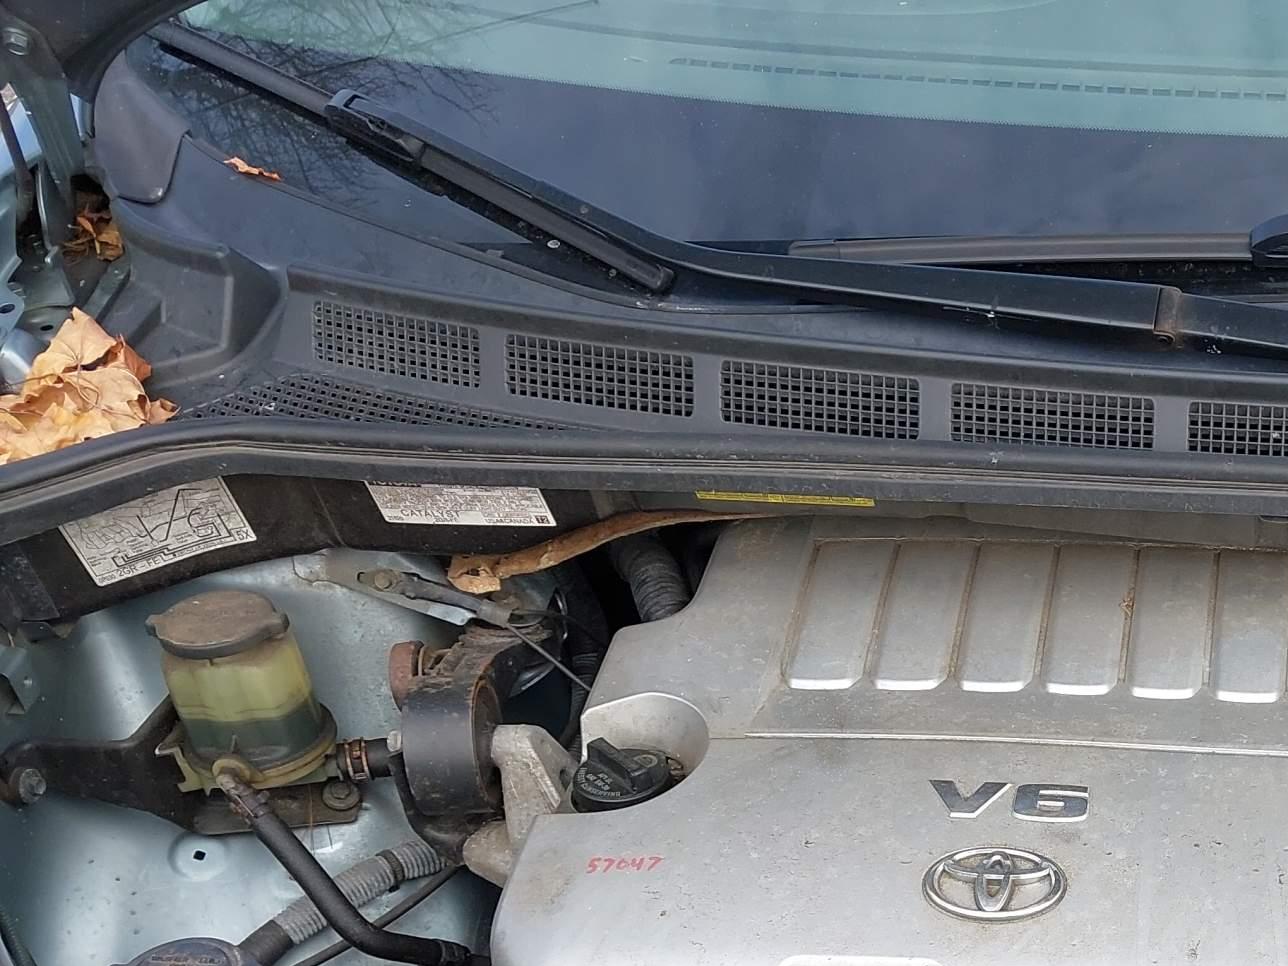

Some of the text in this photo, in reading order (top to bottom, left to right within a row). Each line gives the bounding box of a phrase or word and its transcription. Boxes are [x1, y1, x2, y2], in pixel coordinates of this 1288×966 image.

[400, 509, 460, 518] CATALYST
[236, 528, 252, 540] 5X
[928, 779, 1089, 823] V6
